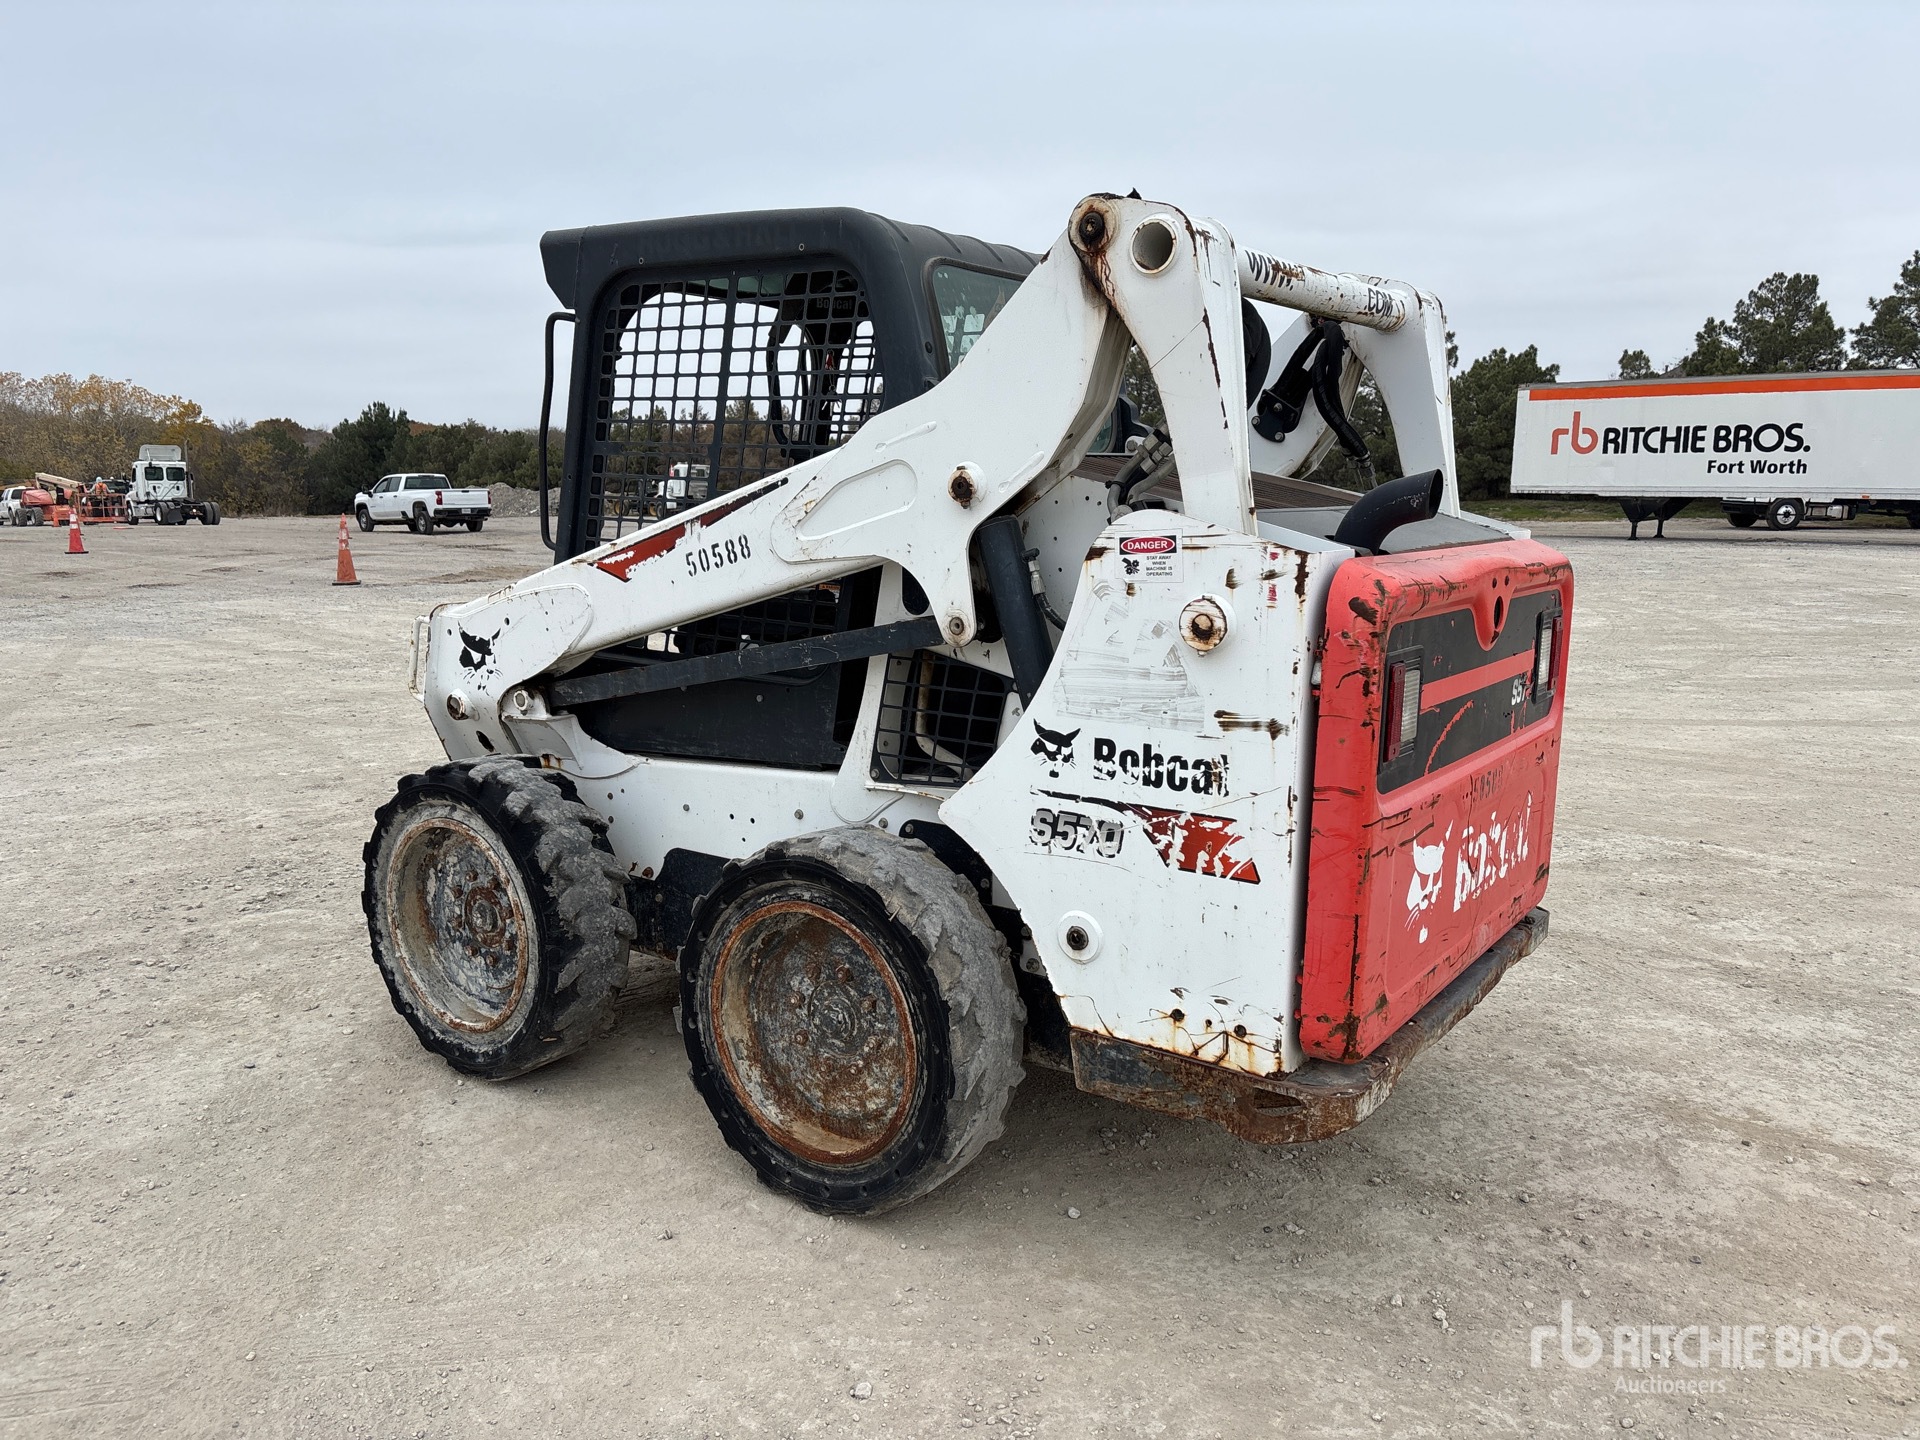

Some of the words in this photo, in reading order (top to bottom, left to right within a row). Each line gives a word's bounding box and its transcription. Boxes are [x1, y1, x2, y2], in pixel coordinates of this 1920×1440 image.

[816, 297, 852, 309] Bocat
[1602, 425, 1708, 454] RITCHIE
[1712, 423, 1811, 453] BROS.
[1706, 460, 1744, 474] Fort
[1750, 459, 1808, 474] Worth
[685, 534, 752, 577] 50588
[1127, 541, 1168, 550] DANGER
[1511, 678, 1530, 705] S57
[1093, 737, 1230, 797] Bobcat
